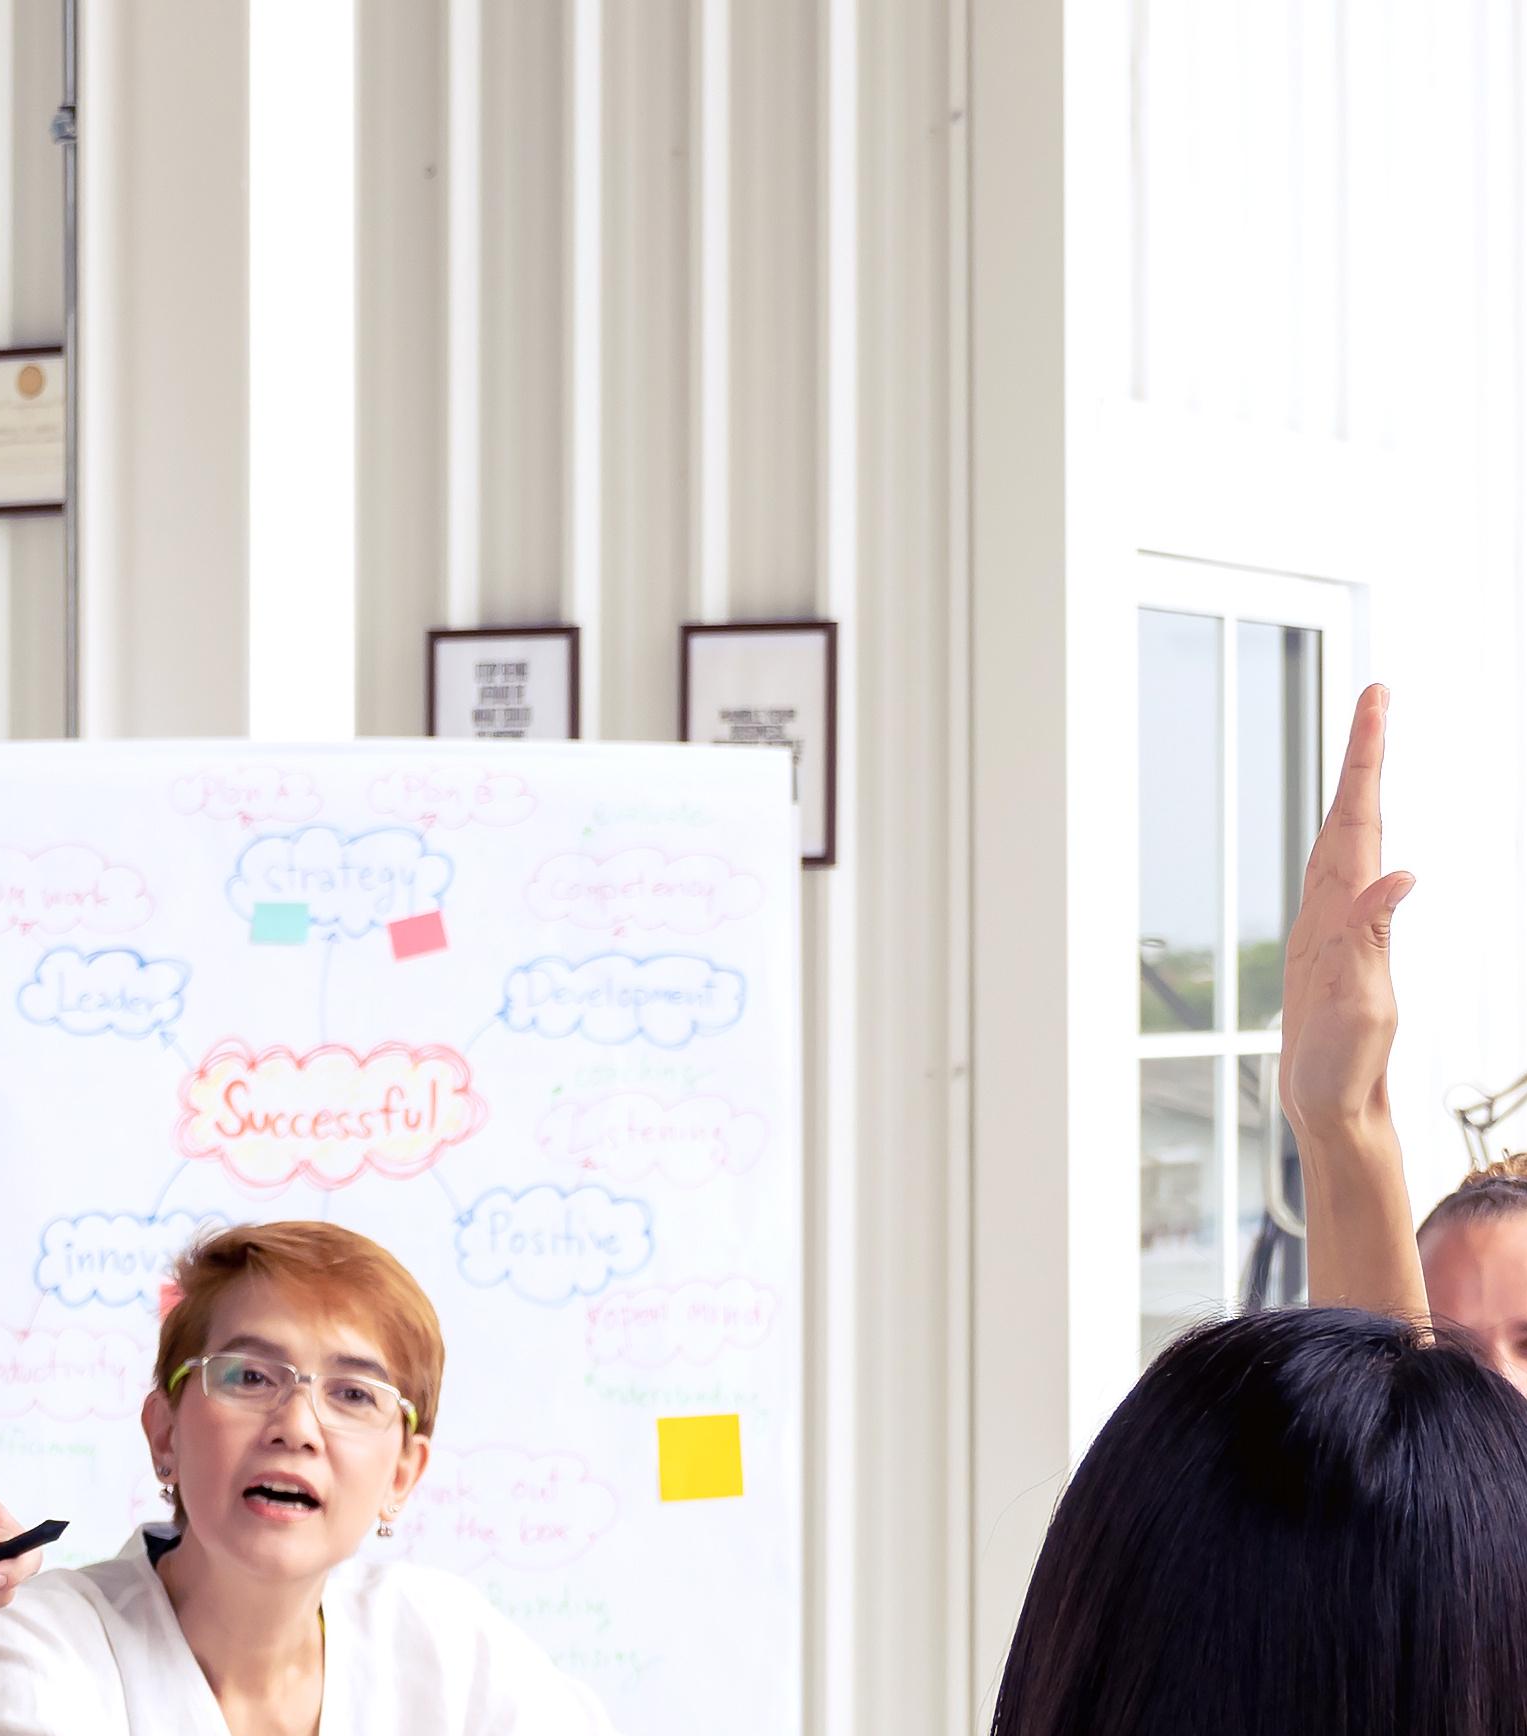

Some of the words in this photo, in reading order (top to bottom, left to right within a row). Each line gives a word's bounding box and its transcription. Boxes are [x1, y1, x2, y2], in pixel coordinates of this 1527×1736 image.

[58, 970, 162, 1014] Leader
[526, 968, 717, 1018] Development
[214, 1078, 439, 1141] Successful
[488, 1206, 623, 1258] Positive
